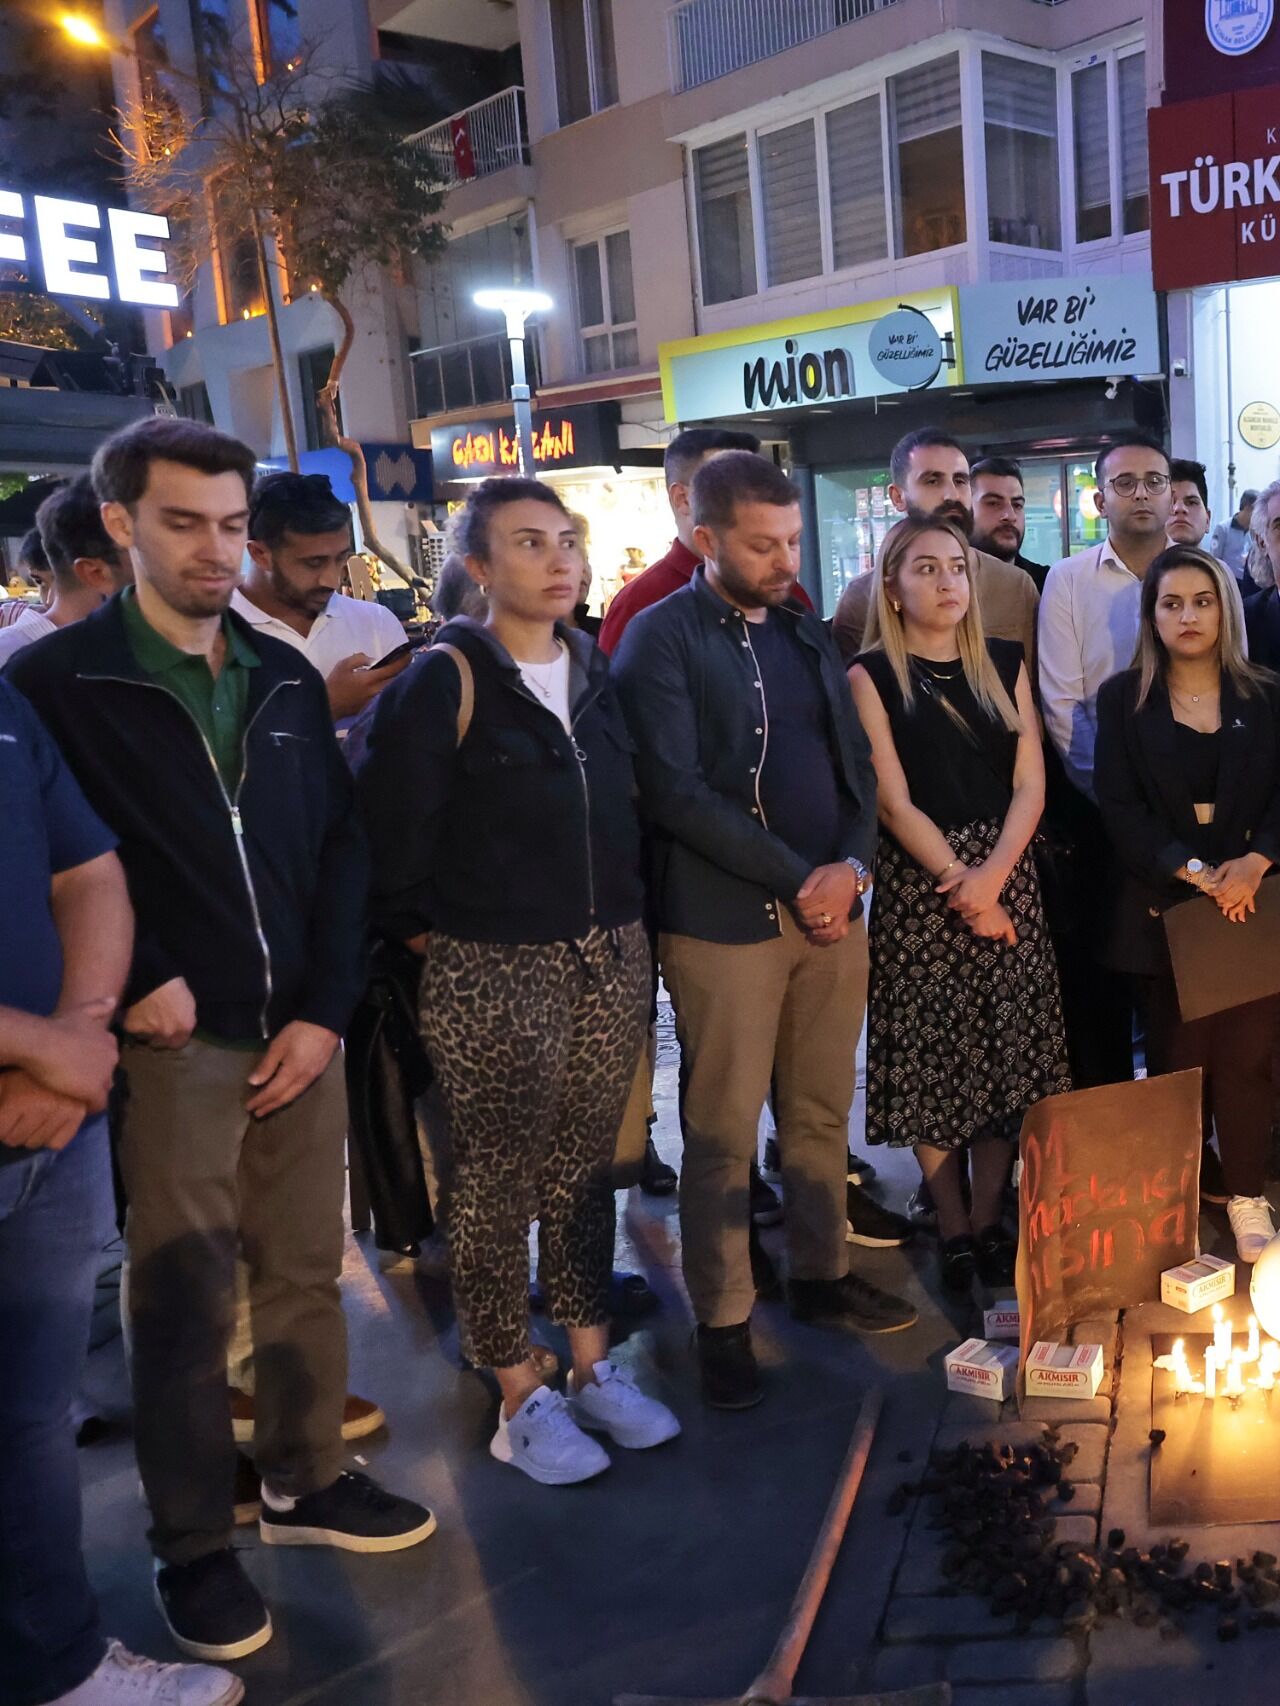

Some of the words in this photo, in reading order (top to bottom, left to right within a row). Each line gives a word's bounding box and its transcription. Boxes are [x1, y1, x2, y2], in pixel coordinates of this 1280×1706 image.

[1017, 296, 1059, 326] VAR
[888, 333, 905, 345] VAR
[985, 327, 1137, 371] GÜZELLİĞİMİZ
[743, 338, 856, 411] mion
[955, 1365, 991, 1382] AKMISIR
[1038, 1371, 1079, 1383] AKMISIR
